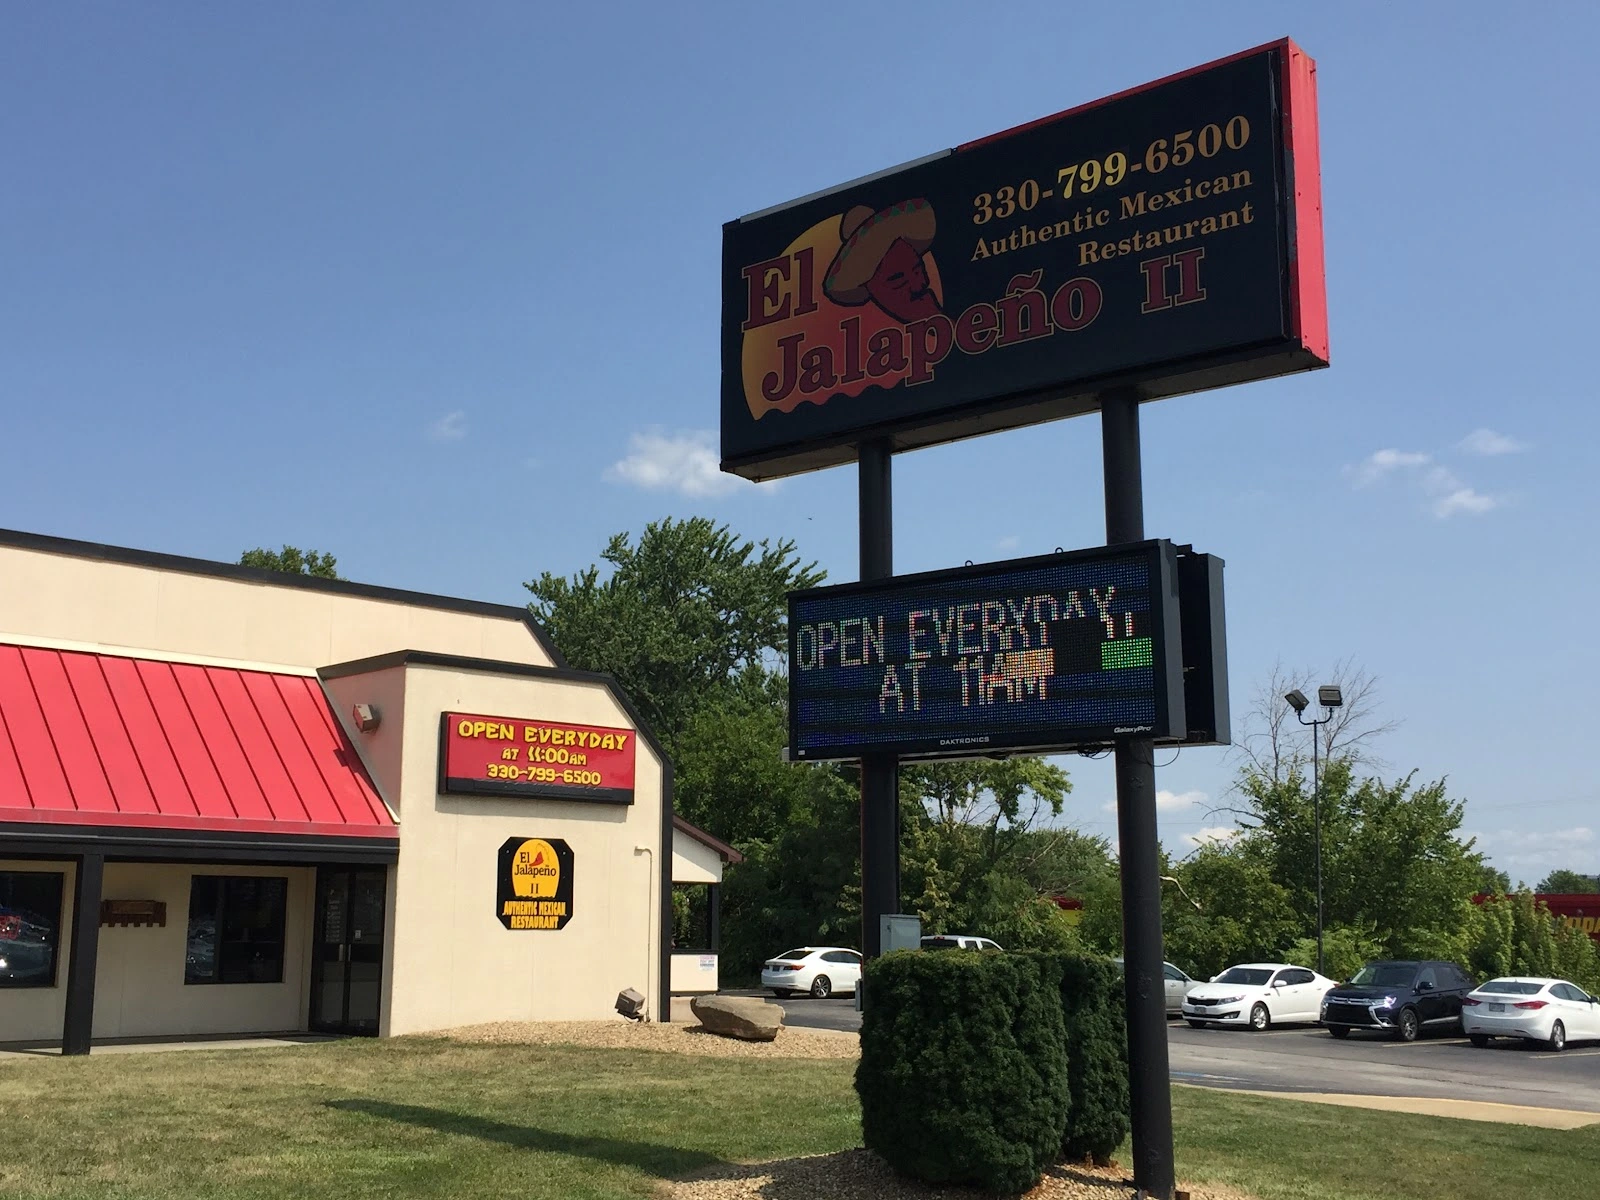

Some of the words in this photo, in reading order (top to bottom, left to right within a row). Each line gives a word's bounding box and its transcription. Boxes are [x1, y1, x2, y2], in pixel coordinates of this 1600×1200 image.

[971, 114, 1252, 227] 330-799-6500
[971, 207, 1112, 262] Authentic
[1118, 169, 1253, 221] Mexican
[1078, 200, 1255, 267] Restaurant
[741, 247, 819, 333] El
[761, 269, 1103, 403] Jalapeño
[1140, 247, 1207, 314] II
[797, 615, 885, 671] OPEN
[879, 661, 927, 714] AT
[458, 721, 515, 741] OPEN
[525, 728, 627, 750] EVERYDAY
[940, 736, 990, 746] DAKTRONICS
[1113, 725, 1152, 733] GalaxyPro
[501, 748, 520, 760] AT
[514, 864, 557, 878] Jalapeño
[520, 852, 530, 864] El
[503, 900, 538, 916] AUTHENTIC
[538, 901, 567, 916] MEXICAN
[510, 915, 560, 929] RESTAURANT
